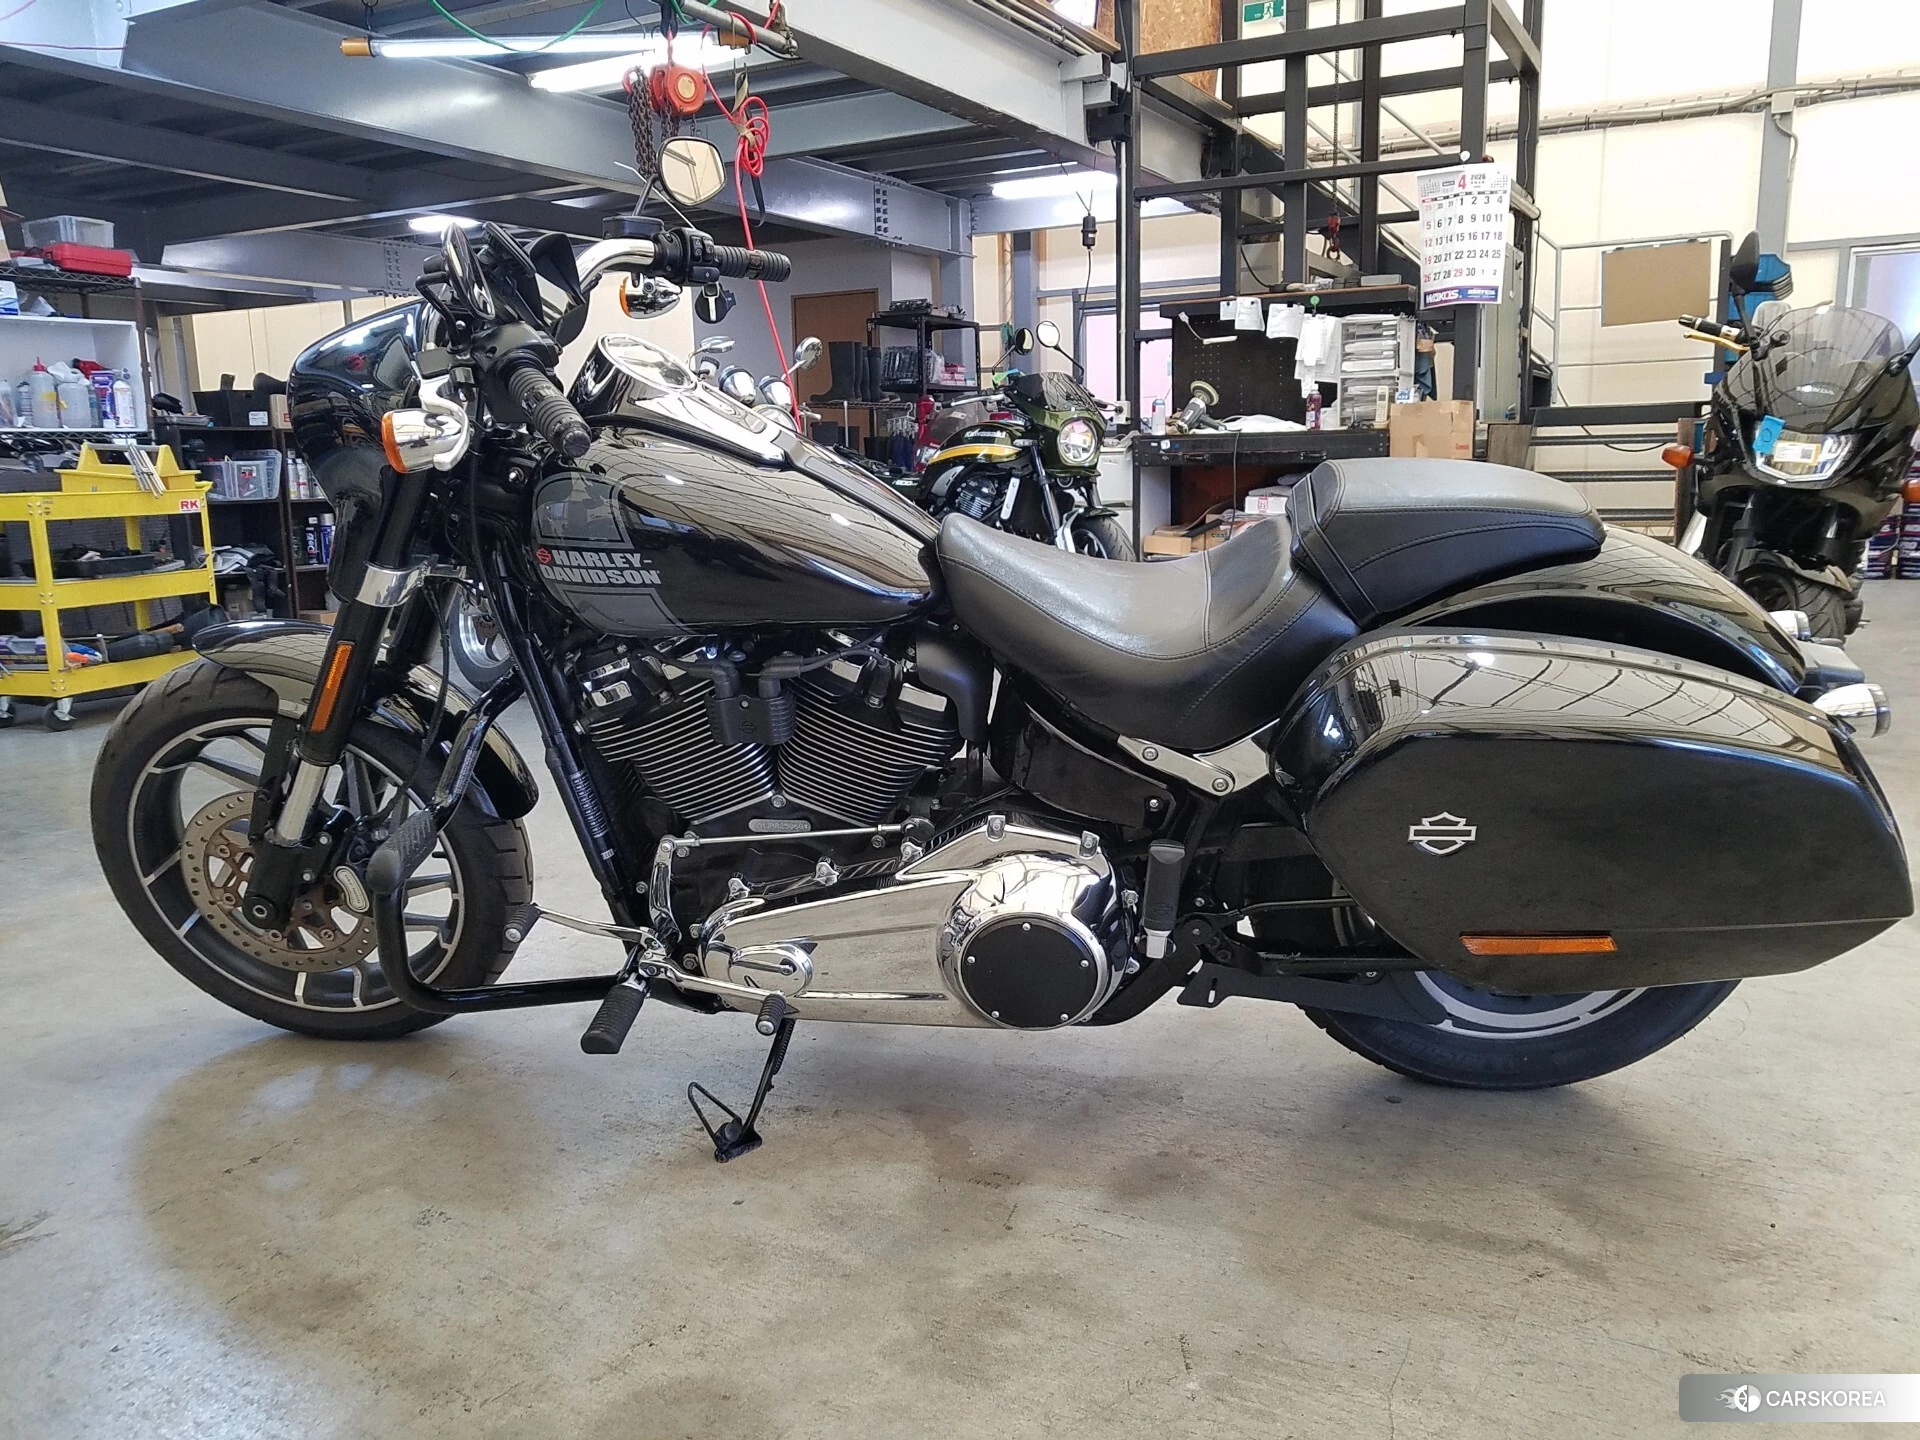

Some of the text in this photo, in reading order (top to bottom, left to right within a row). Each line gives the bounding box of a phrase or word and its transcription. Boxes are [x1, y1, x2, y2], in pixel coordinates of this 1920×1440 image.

[1458, 174, 1466, 189] 4
[1470, 173, 1486, 181] 2026
[1459, 197, 1464, 206] 1
[1471, 196, 1478, 205] 2
[1484, 196, 1490, 204] 3
[1496, 196, 1503, 204] 4
[1426, 213, 1503, 230] 5 6 7 8 9 10 11
[1425, 232, 1503, 248] 12 13 14 15 16 17 18
[1424, 249, 1501, 265] 19 20 21 22 23 24 25
[1423, 274, 1432, 283] 26
[1433, 272, 1441, 281] 27
[1443, 269, 1451, 279] 28
[1453, 268, 1463, 278] 29
[1465, 267, 1476, 276] 30
[180, 500, 199, 509] RK
[551, 549, 653, 568] HARLEY-
[539, 563, 662, 584] DAVIDSON
